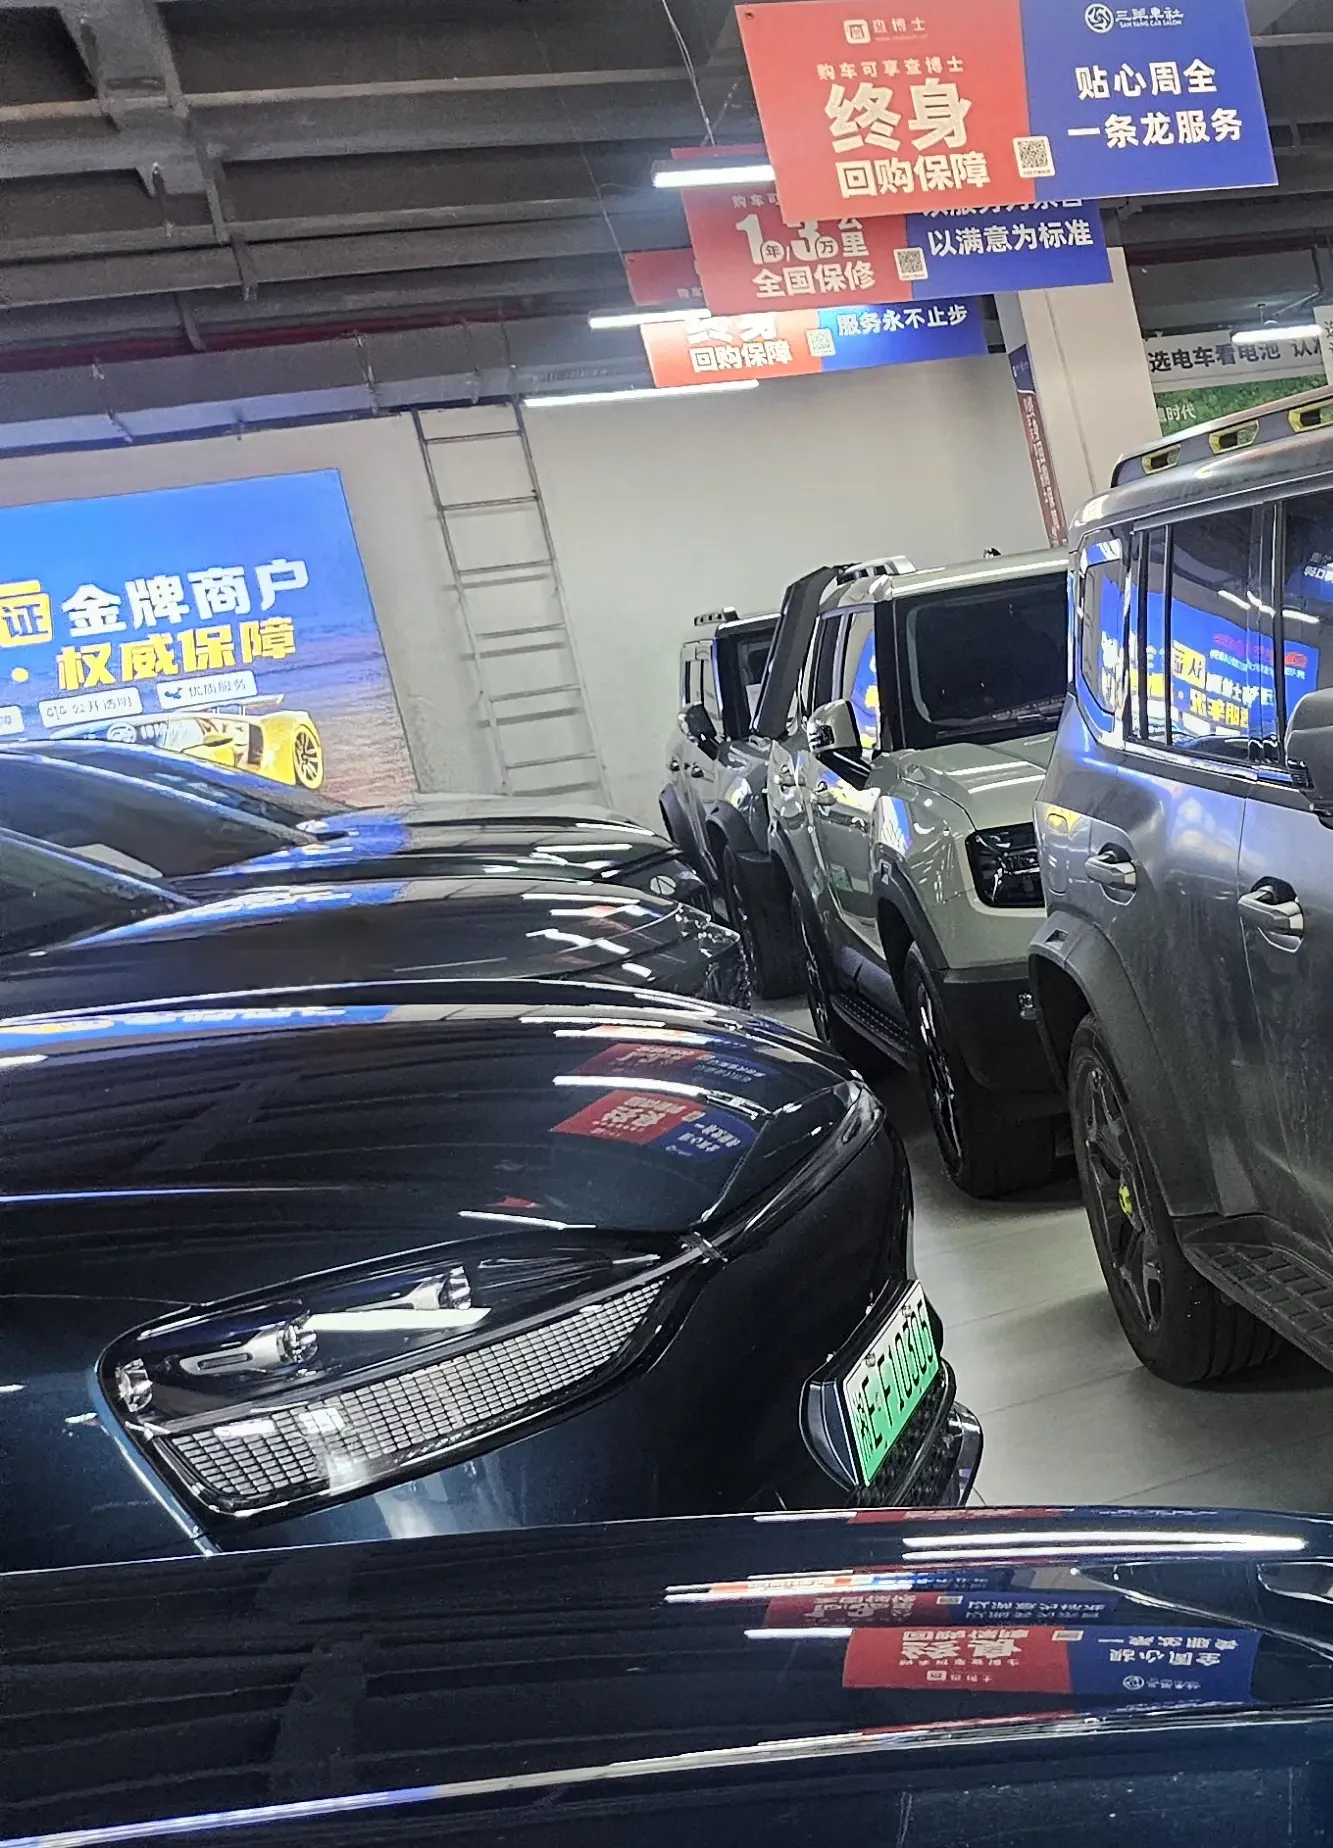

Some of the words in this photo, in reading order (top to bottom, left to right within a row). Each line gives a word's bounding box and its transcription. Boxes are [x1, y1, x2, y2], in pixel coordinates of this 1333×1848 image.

[817, 55, 964, 81] 购车可享查博士
[1075, 58, 1217, 100] 贴心周全
[824, 78, 972, 153] 终身
[1068, 108, 1242, 149] 一条龙服务
[835, 151, 990, 198] 回购保障
[927, 219, 1093, 257] 以满意为标准
[752, 261, 875, 298] 全国保修
[837, 305, 967, 336] 服务永不止步
[689, 339, 793, 373] 回购保障
[1148, 342, 1281, 373] 选电车看电池
[1159, 404, 1196, 422] 时代
[62, 558, 310, 637] 金牌商户
[57, 616, 296, 690] 权威保障
